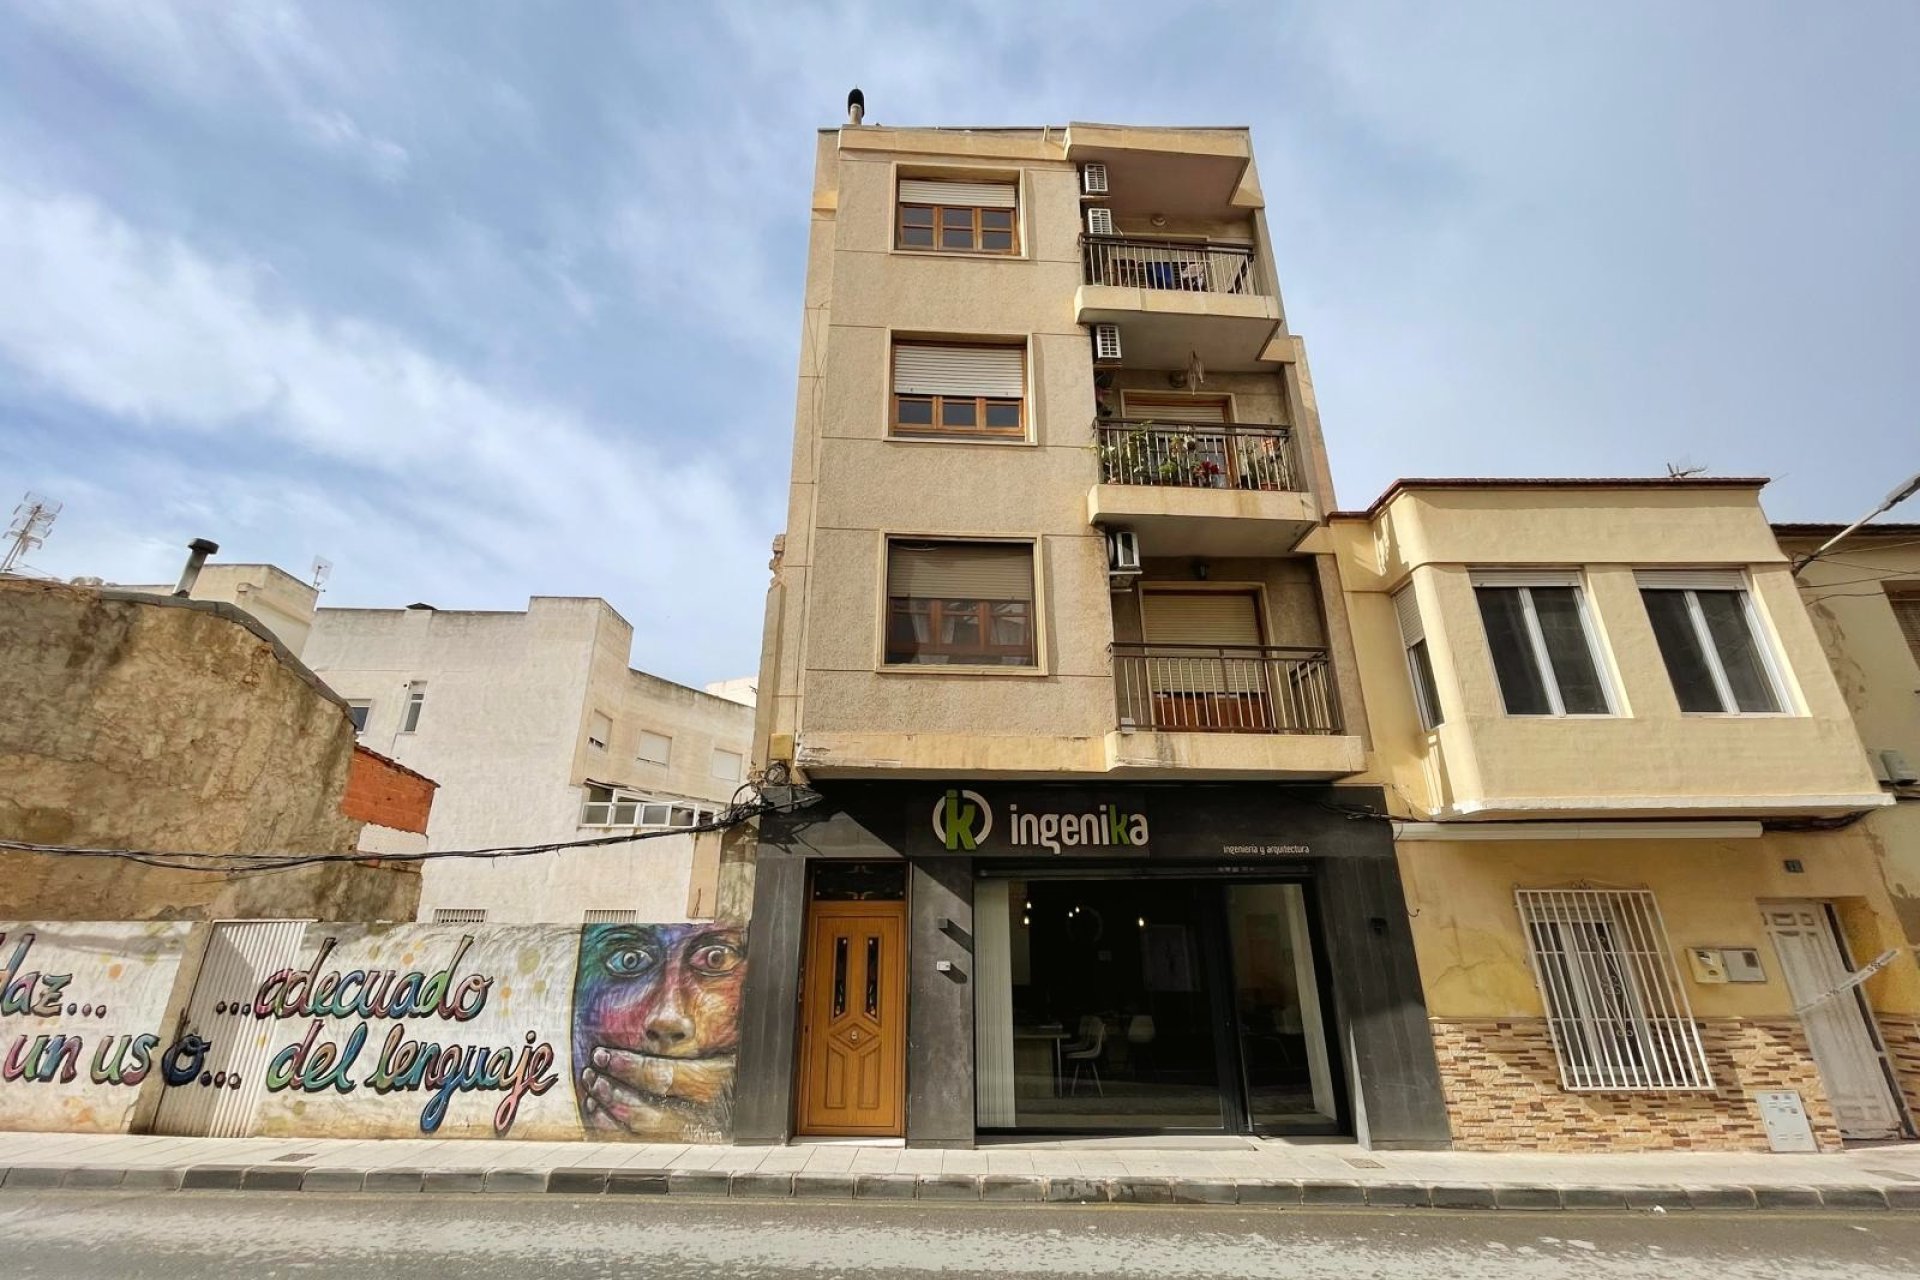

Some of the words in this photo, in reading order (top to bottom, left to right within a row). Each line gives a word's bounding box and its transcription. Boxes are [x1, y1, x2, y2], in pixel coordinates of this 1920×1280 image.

[1010, 803, 1149, 855] ingenika
[0, 932, 107, 1018] daz...
[3, 1033, 83, 1084] un
[265, 1019, 368, 1095] del
[364, 1022, 558, 1137] lenguaje
